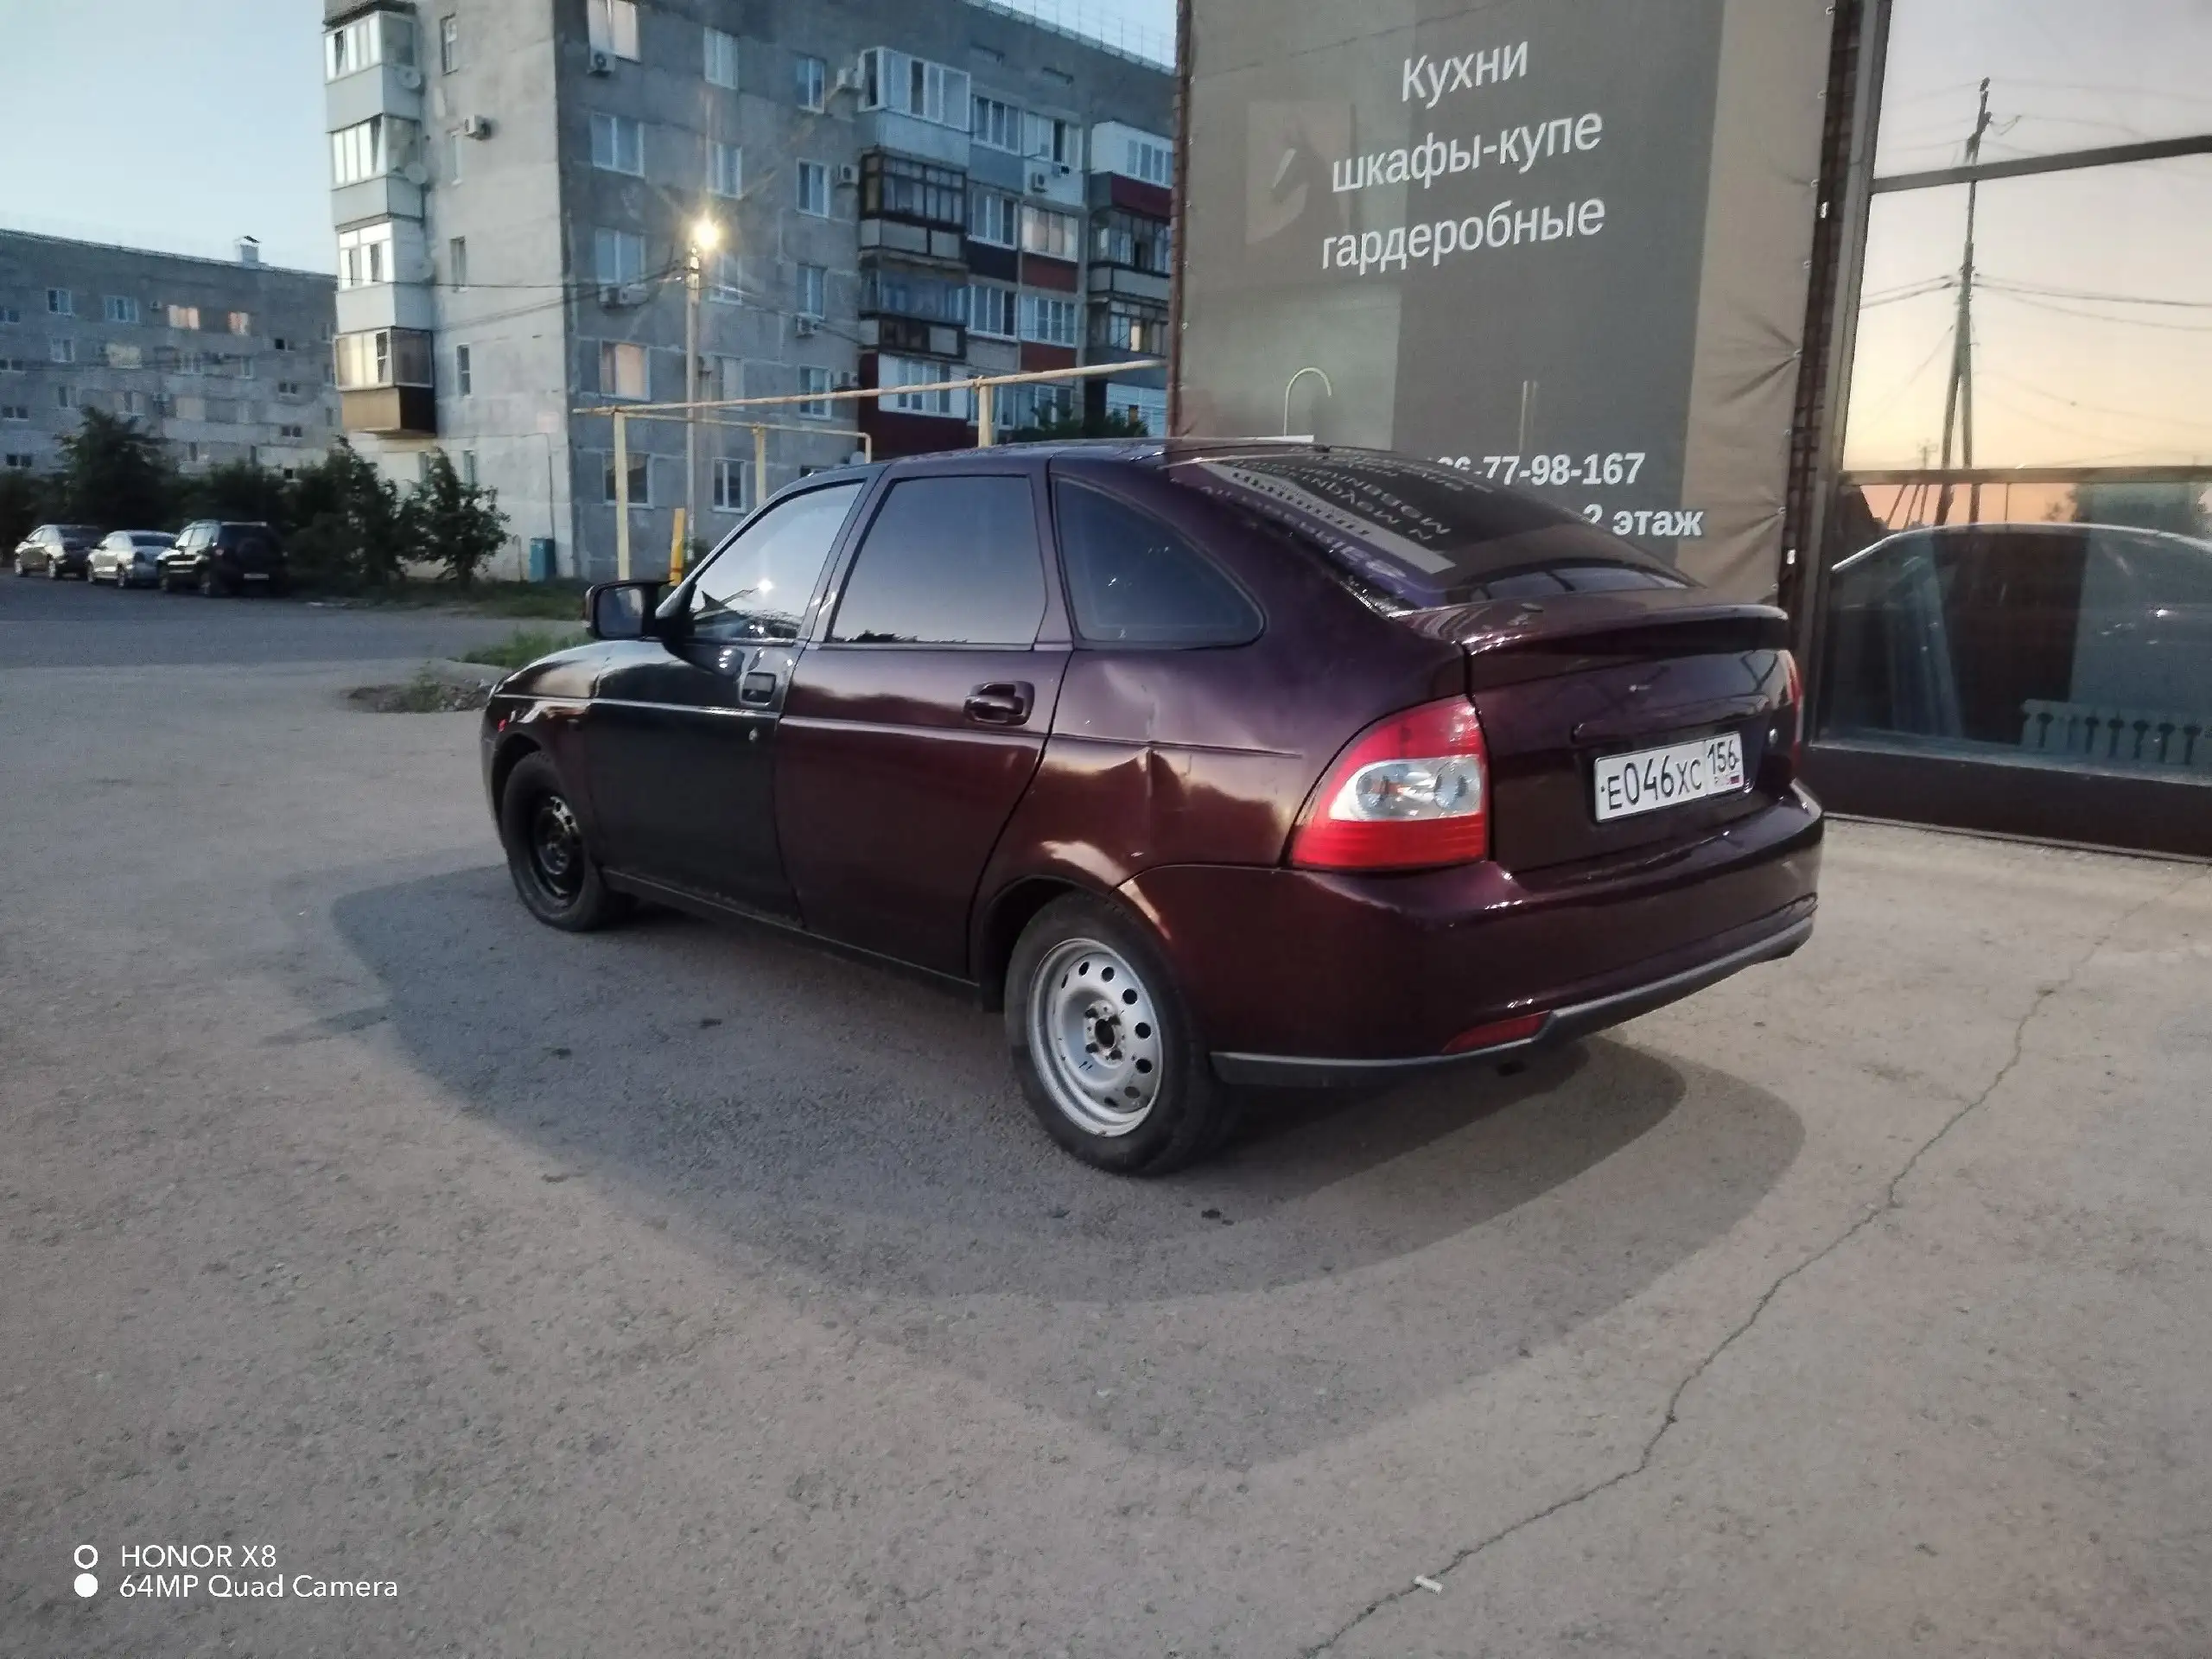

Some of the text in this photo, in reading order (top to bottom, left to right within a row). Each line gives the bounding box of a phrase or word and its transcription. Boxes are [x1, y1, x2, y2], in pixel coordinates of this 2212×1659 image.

[1401, 41, 1529, 109] Кухни
[1332, 111, 1603, 193] шкафы-купе
[1321, 197, 1606, 276] гардеробные
[1612, 509, 1704, 536] этаж
